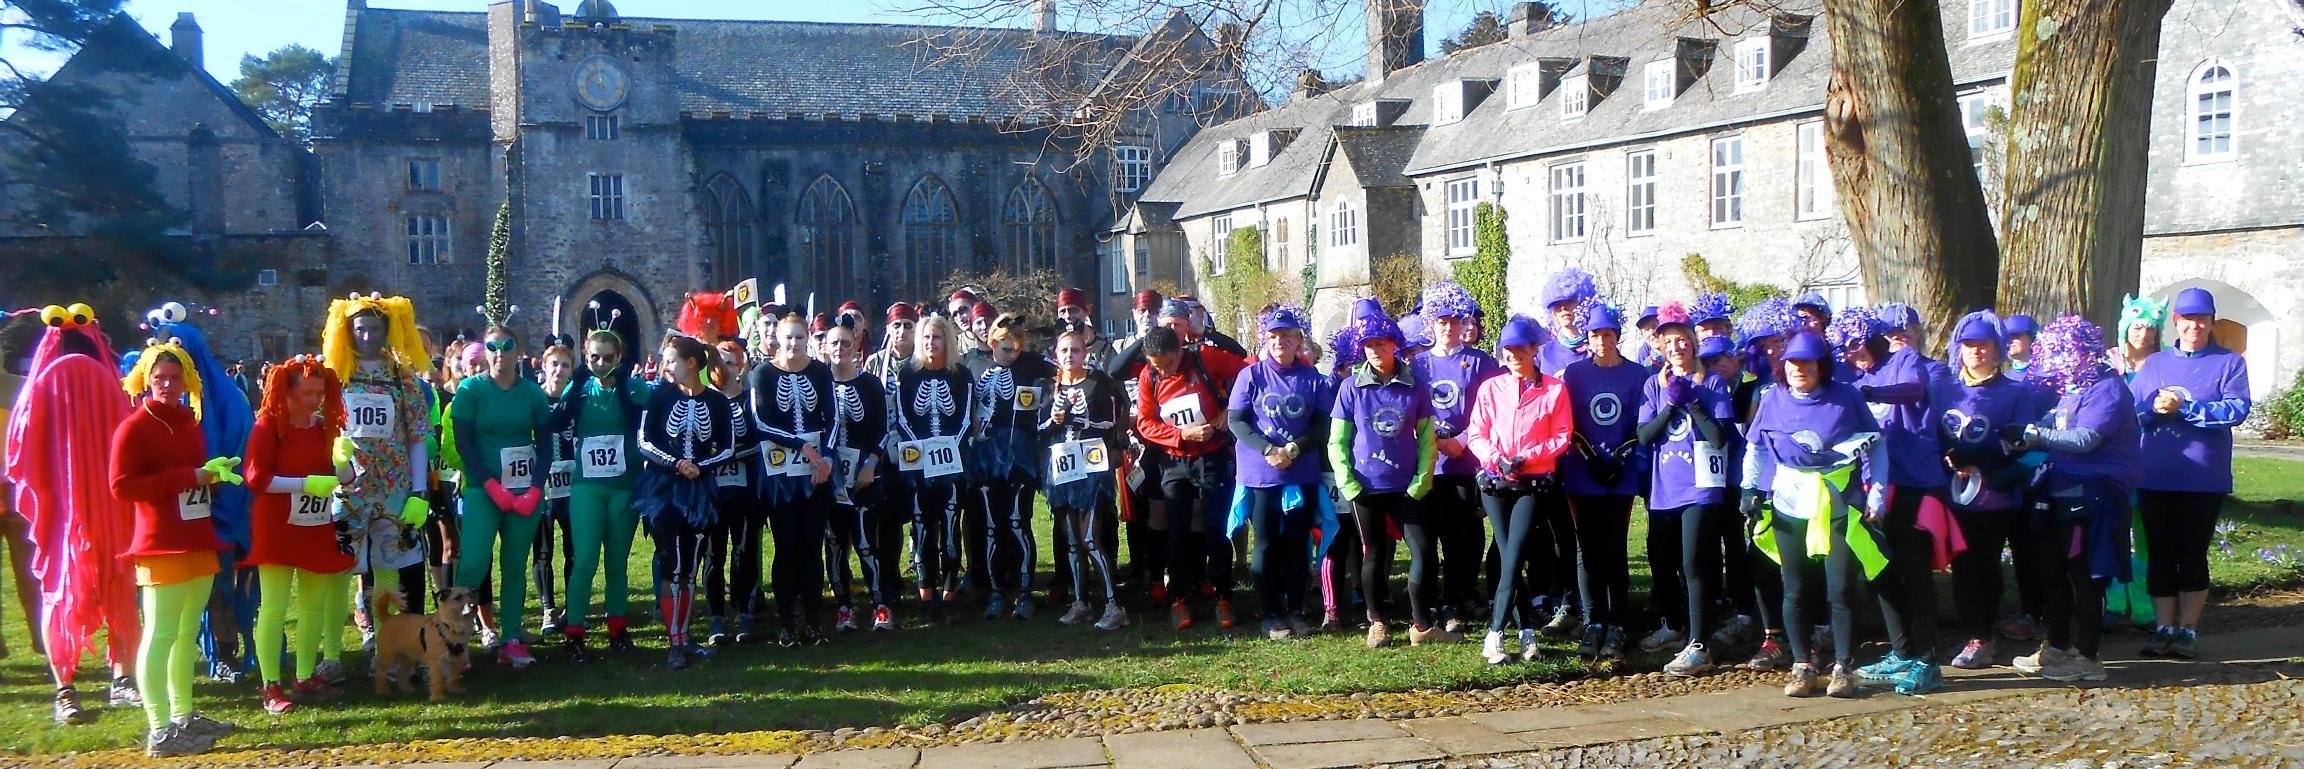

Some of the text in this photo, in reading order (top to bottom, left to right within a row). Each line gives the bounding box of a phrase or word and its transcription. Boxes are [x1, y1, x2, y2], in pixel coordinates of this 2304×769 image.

[353, 407, 387, 425] 105
[1170, 408, 1195, 426] 277
[588, 448, 617, 466] 132
[928, 447, 953, 466] 110
[1056, 454, 1075, 473] 187
